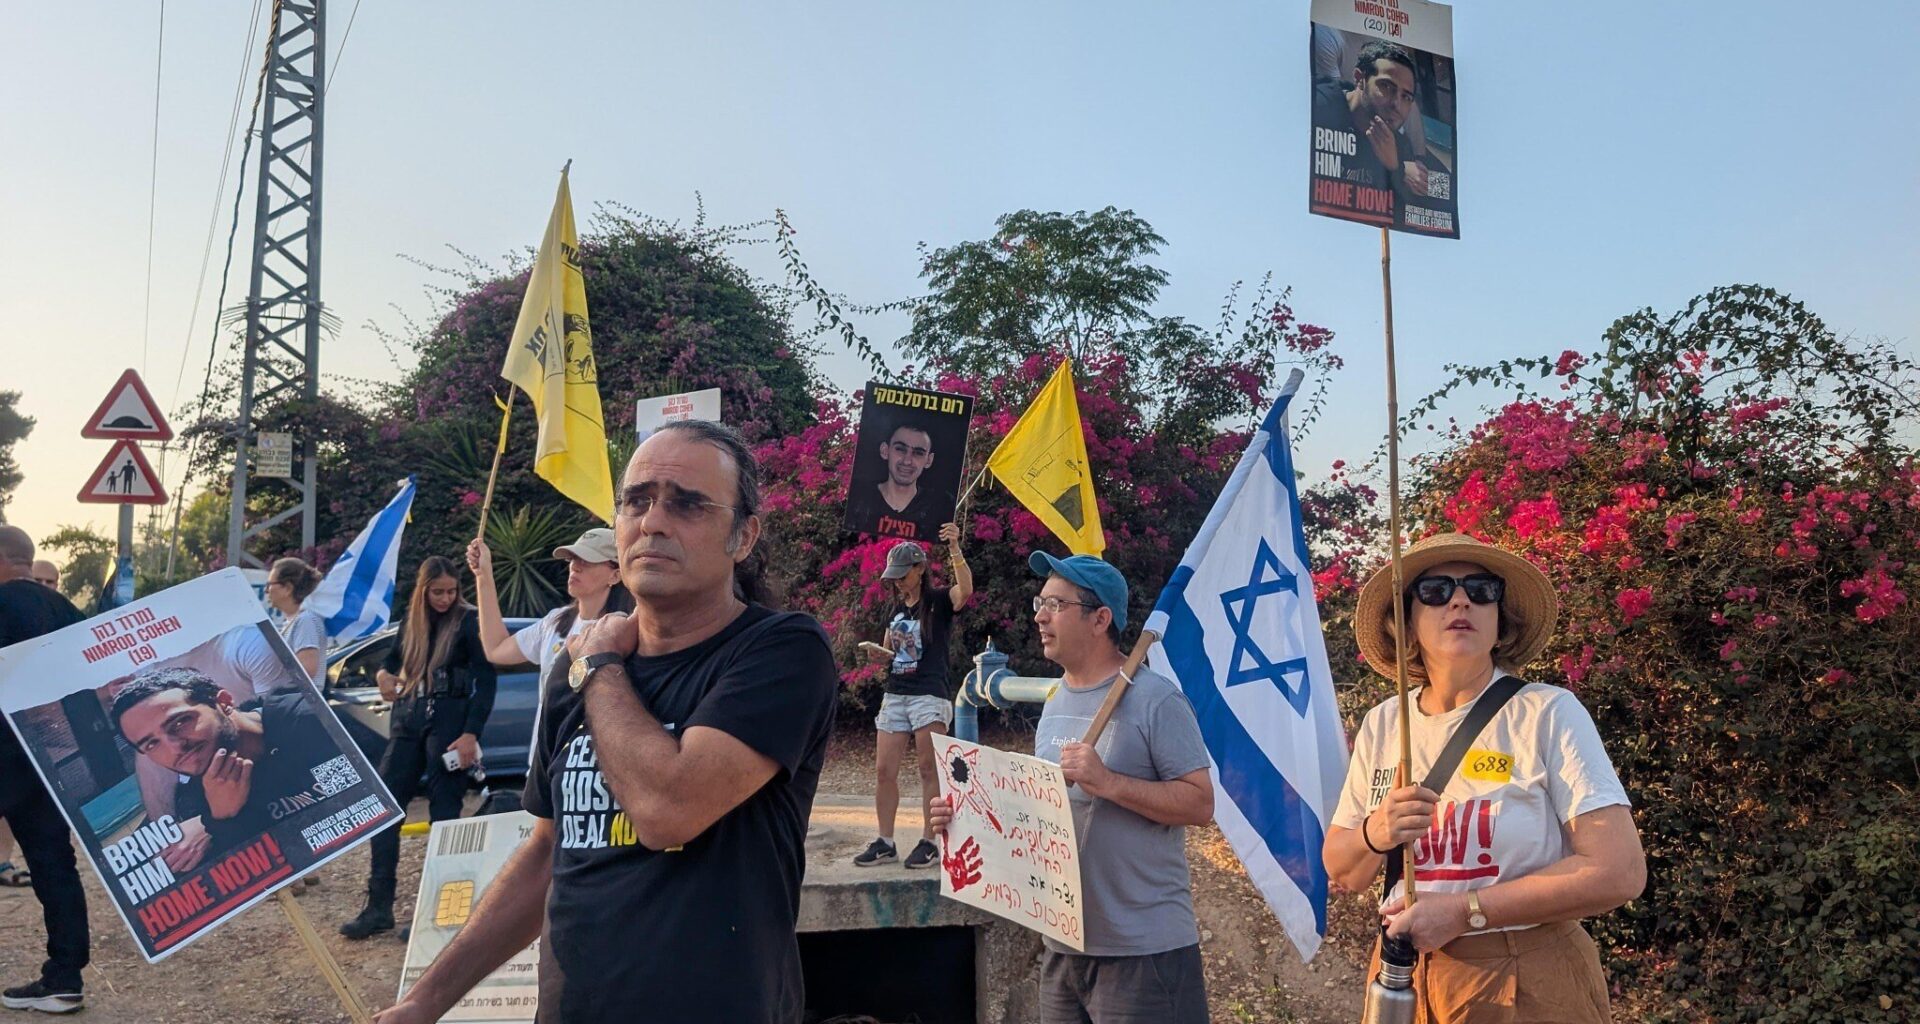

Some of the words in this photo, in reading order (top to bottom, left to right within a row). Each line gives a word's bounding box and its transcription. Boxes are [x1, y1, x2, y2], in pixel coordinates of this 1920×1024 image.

[1364, 16, 1387, 35] (20)
[1386, 7, 1410, 26] COHEN
[1315, 126, 1357, 156] BRING
[1315, 151, 1341, 178] HIM
[1315, 178, 1352, 208] HOME
[1356, 185, 1394, 216] NOW!
[873, 386, 939, 411] ברסלבסקי
[941, 397, 964, 416] רום
[877, 515, 917, 538] הצילו
[90, 621, 117, 642] כהן
[115, 607, 156, 631] נמרוד
[82, 632, 138, 664] NIMROD
[136, 615, 183, 642] COHEN
[128, 643, 158, 666] (19)
[1010, 761, 1026, 775] את
[1473, 755, 1508, 773] 688
[561, 770, 622, 812] HOS
[990, 771, 1063, 809] המלחמה
[301, 815, 337, 839] HOSTAGES
[335, 810, 351, 824] AND
[348, 793, 380, 816] MISSING
[306, 819, 354, 852] FAMILIES
[350, 801, 388, 829] FORUM
[1015, 811, 1030, 823] את
[560, 813, 608, 849] DEAL
[609, 811, 639, 847] NO
[102, 814, 184, 876] BRING
[118, 856, 177, 905] HIM
[138, 875, 216, 938] HOME
[209, 832, 287, 896] NOW!
[1028, 874, 1046, 890] את
[981, 883, 1022, 910] הדמים
[1051, 882, 1075, 909] עצרו
[1024, 896, 1080, 941] שפיכות
